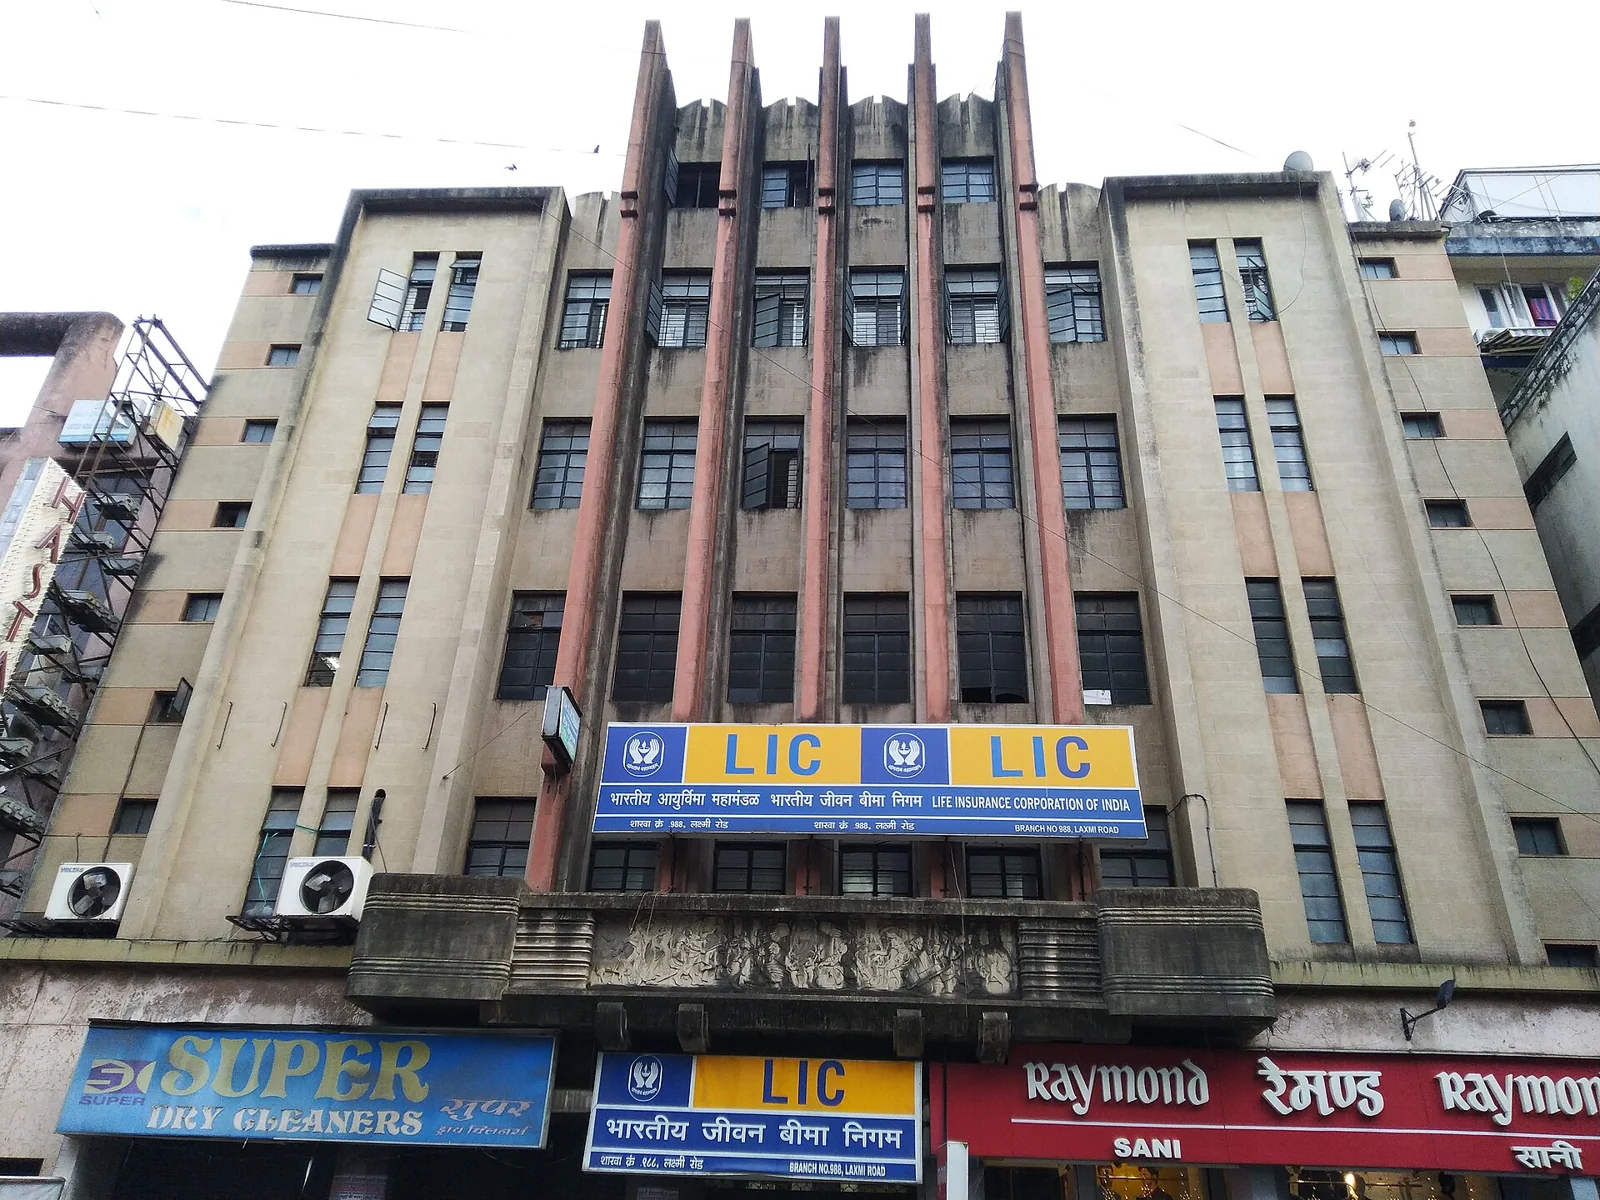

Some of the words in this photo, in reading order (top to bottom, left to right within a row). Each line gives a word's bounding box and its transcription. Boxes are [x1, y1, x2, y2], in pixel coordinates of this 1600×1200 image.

[725, 733, 822, 776] LIC
[990, 735, 1091, 779] LIC
[610, 789, 652, 806] भारतीय
[657, 789, 707, 810] आयुर्विमा
[711, 789, 760, 807] महामंडळ
[770, 790, 813, 807] भारतीय
[819, 790, 853, 807] जीवन
[859, 790, 886, 807] बीमा
[891, 791, 923, 807] निगम
[931, 795, 952, 808] LIFE
[955, 796, 1012, 809] INSURANCE
[1013, 798, 1083, 811] CORPORATION
[1086, 798, 1099, 811] OF
[1102, 799, 1131, 812] INDIA
[715, 818, 729, 828] रोड
[901, 820, 915, 830] रोड
[1014, 824, 1045, 833] BRANCH
[1046, 825, 1058, 833] NO
[1058, 825, 1073, 834] 988,
[1074, 825, 1097, 834] LAXMI
[1098, 826, 1119, 834] ROAD
[160, 1035, 431, 1103] SUPER
[762, 1059, 845, 1107] LIC
[1257, 1056, 1385, 1117] रेमण्ड
[78, 1095, 145, 1107] SUPER
[440, 1098, 535, 1121] सुपर
[147, 1104, 224, 1130] DRY
[232, 1107, 423, 1136] CLEANERS
[606, 1114, 690, 1142] भारतीय
[701, 1116, 767, 1144] जीवन
[778, 1119, 830, 1147] बीमा
[842, 1121, 904, 1149] निगम
[1113, 1137, 1182, 1159] SANI
[1510, 1139, 1583, 1170] सानी
[689, 1156, 704, 1170] रोड
[789, 1162, 817, 1174] BRANCH
[845, 1165, 866, 1177] LAXMI
[867, 1166, 886, 1177] ROAD
